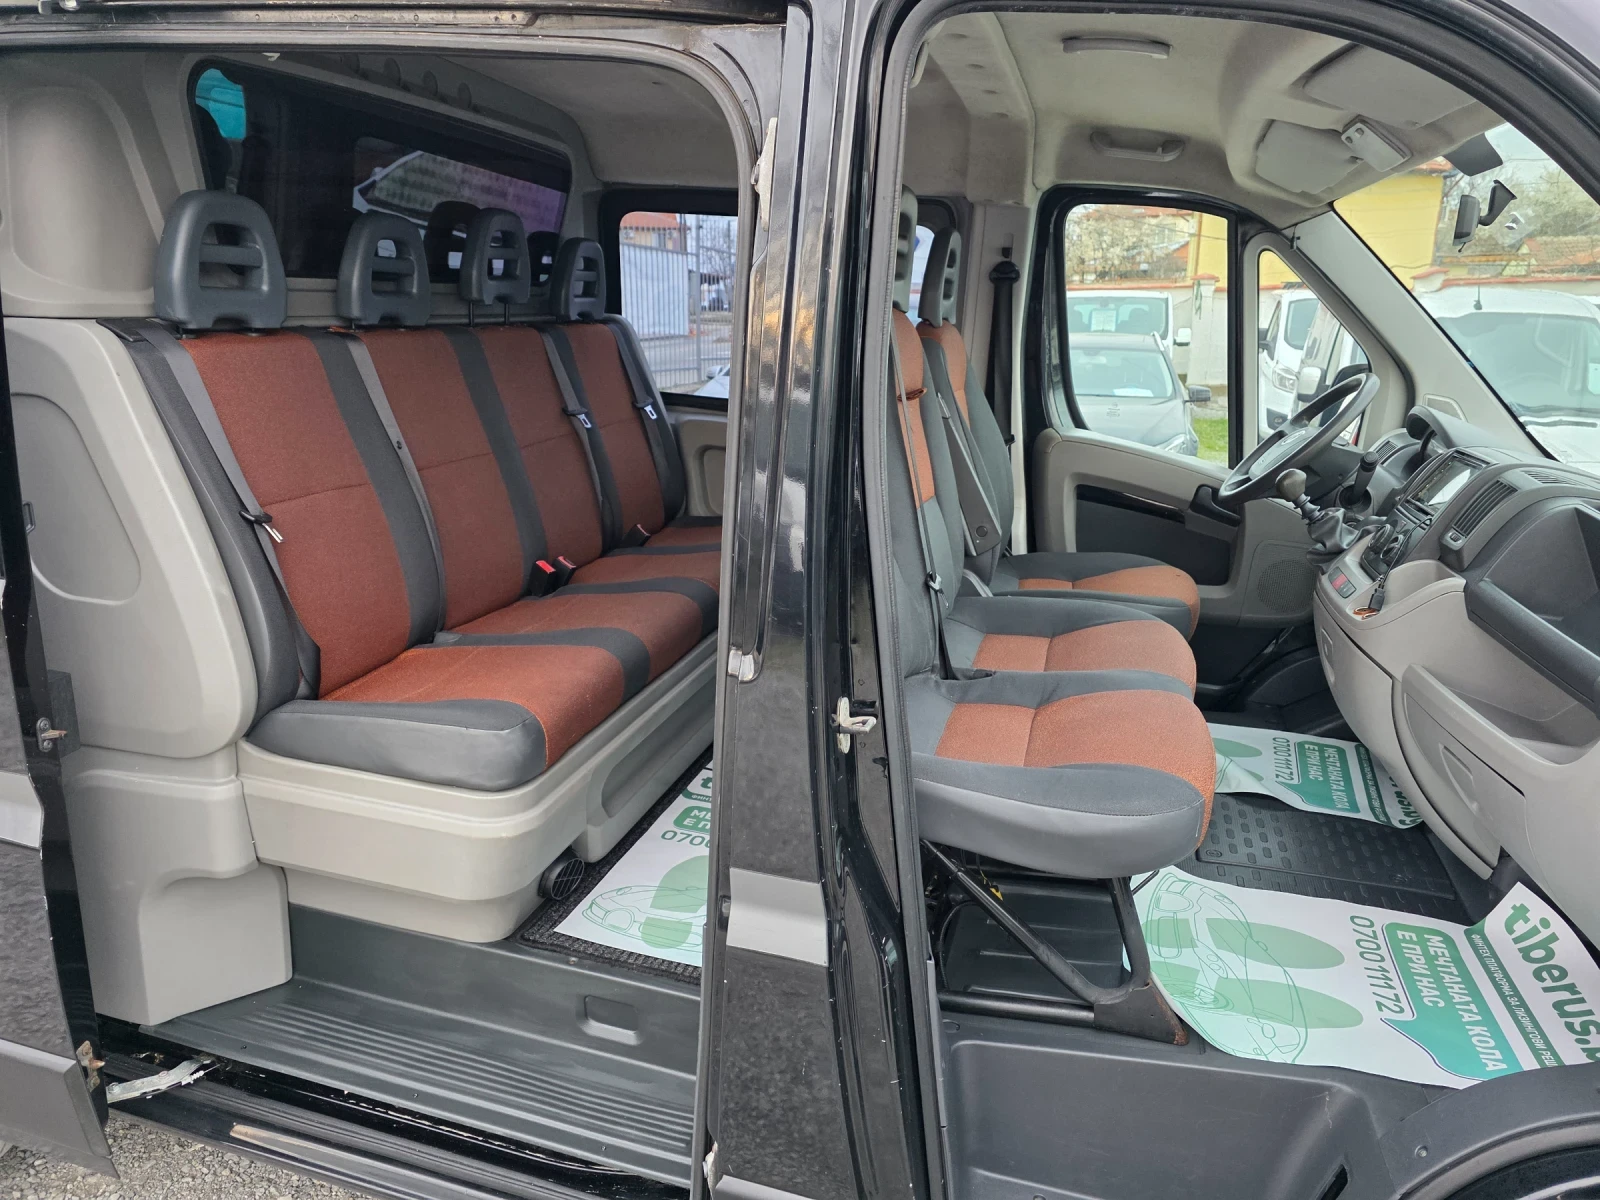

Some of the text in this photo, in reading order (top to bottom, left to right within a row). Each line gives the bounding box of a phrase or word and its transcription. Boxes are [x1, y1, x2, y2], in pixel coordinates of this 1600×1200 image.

[1471, 933, 1491, 959] ФИНТЕХ
[1396, 930, 1446, 1008] Е ПРИ НАС
[1484, 957, 1514, 996] ПЛАТФОРМА
[1423, 933, 1508, 1072] МЕЧТАНАТА КОЛА
[1506, 995, 1522, 1009] ЗА
[1512, 1005, 1548, 1050] ЛИЗИНГОВИ
